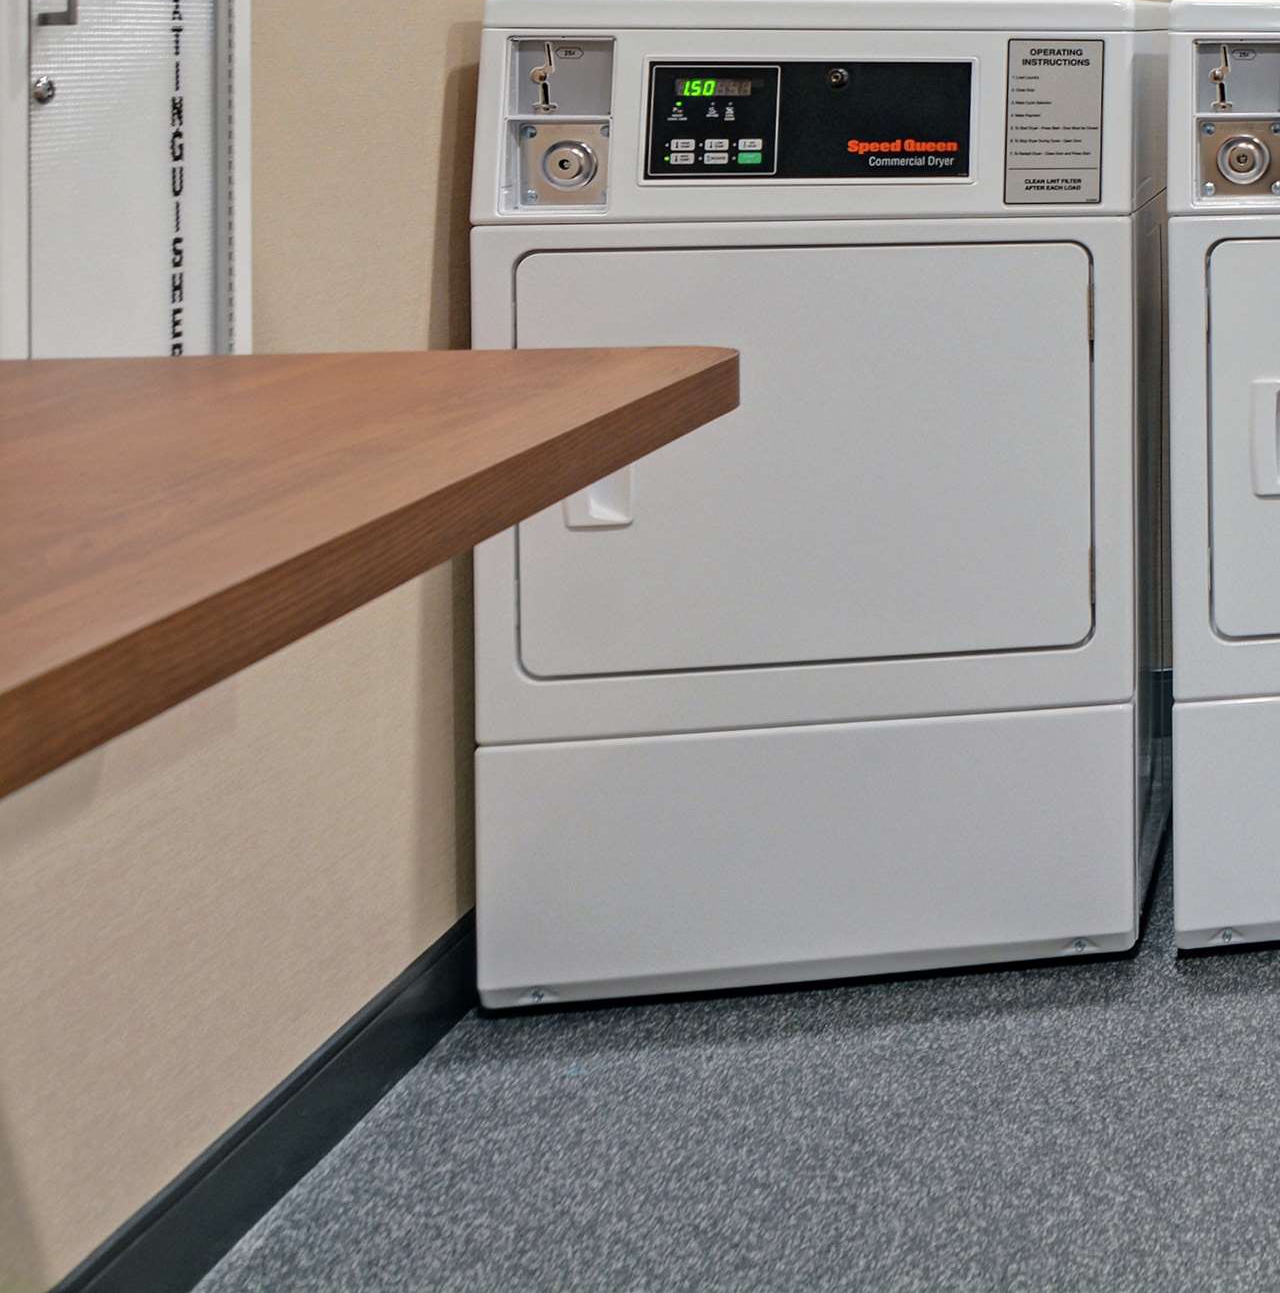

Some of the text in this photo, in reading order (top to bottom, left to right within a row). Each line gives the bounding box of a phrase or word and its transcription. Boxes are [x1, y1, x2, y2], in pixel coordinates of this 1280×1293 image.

[1030, 48, 1084, 57] OPERATING
[1022, 58, 1090, 67] INSTRUCTIONS
[847, 139, 958, 154] Speed Queen
[868, 155, 955, 168] Commercial Dryer
